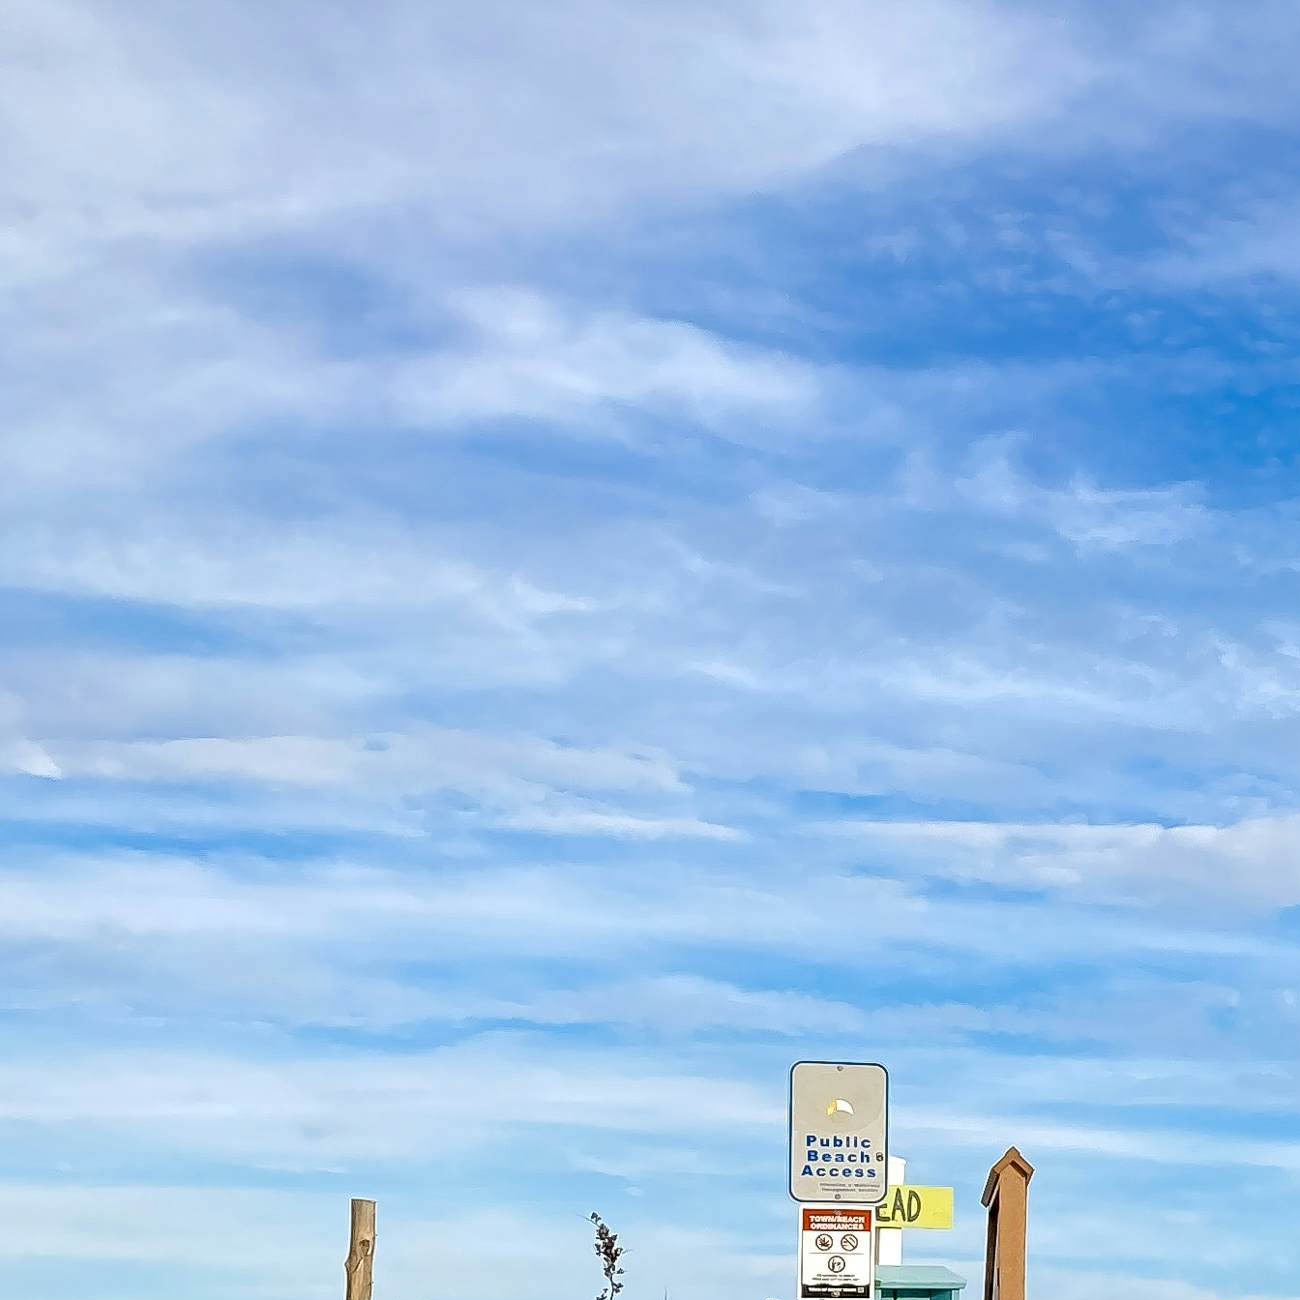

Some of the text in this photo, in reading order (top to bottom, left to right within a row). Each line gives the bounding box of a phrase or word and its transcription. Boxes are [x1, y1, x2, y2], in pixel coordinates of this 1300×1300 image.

[806, 1135, 872, 1148] Public
[807, 1149, 870, 1163] Beach
[801, 1164, 877, 1178] Access
